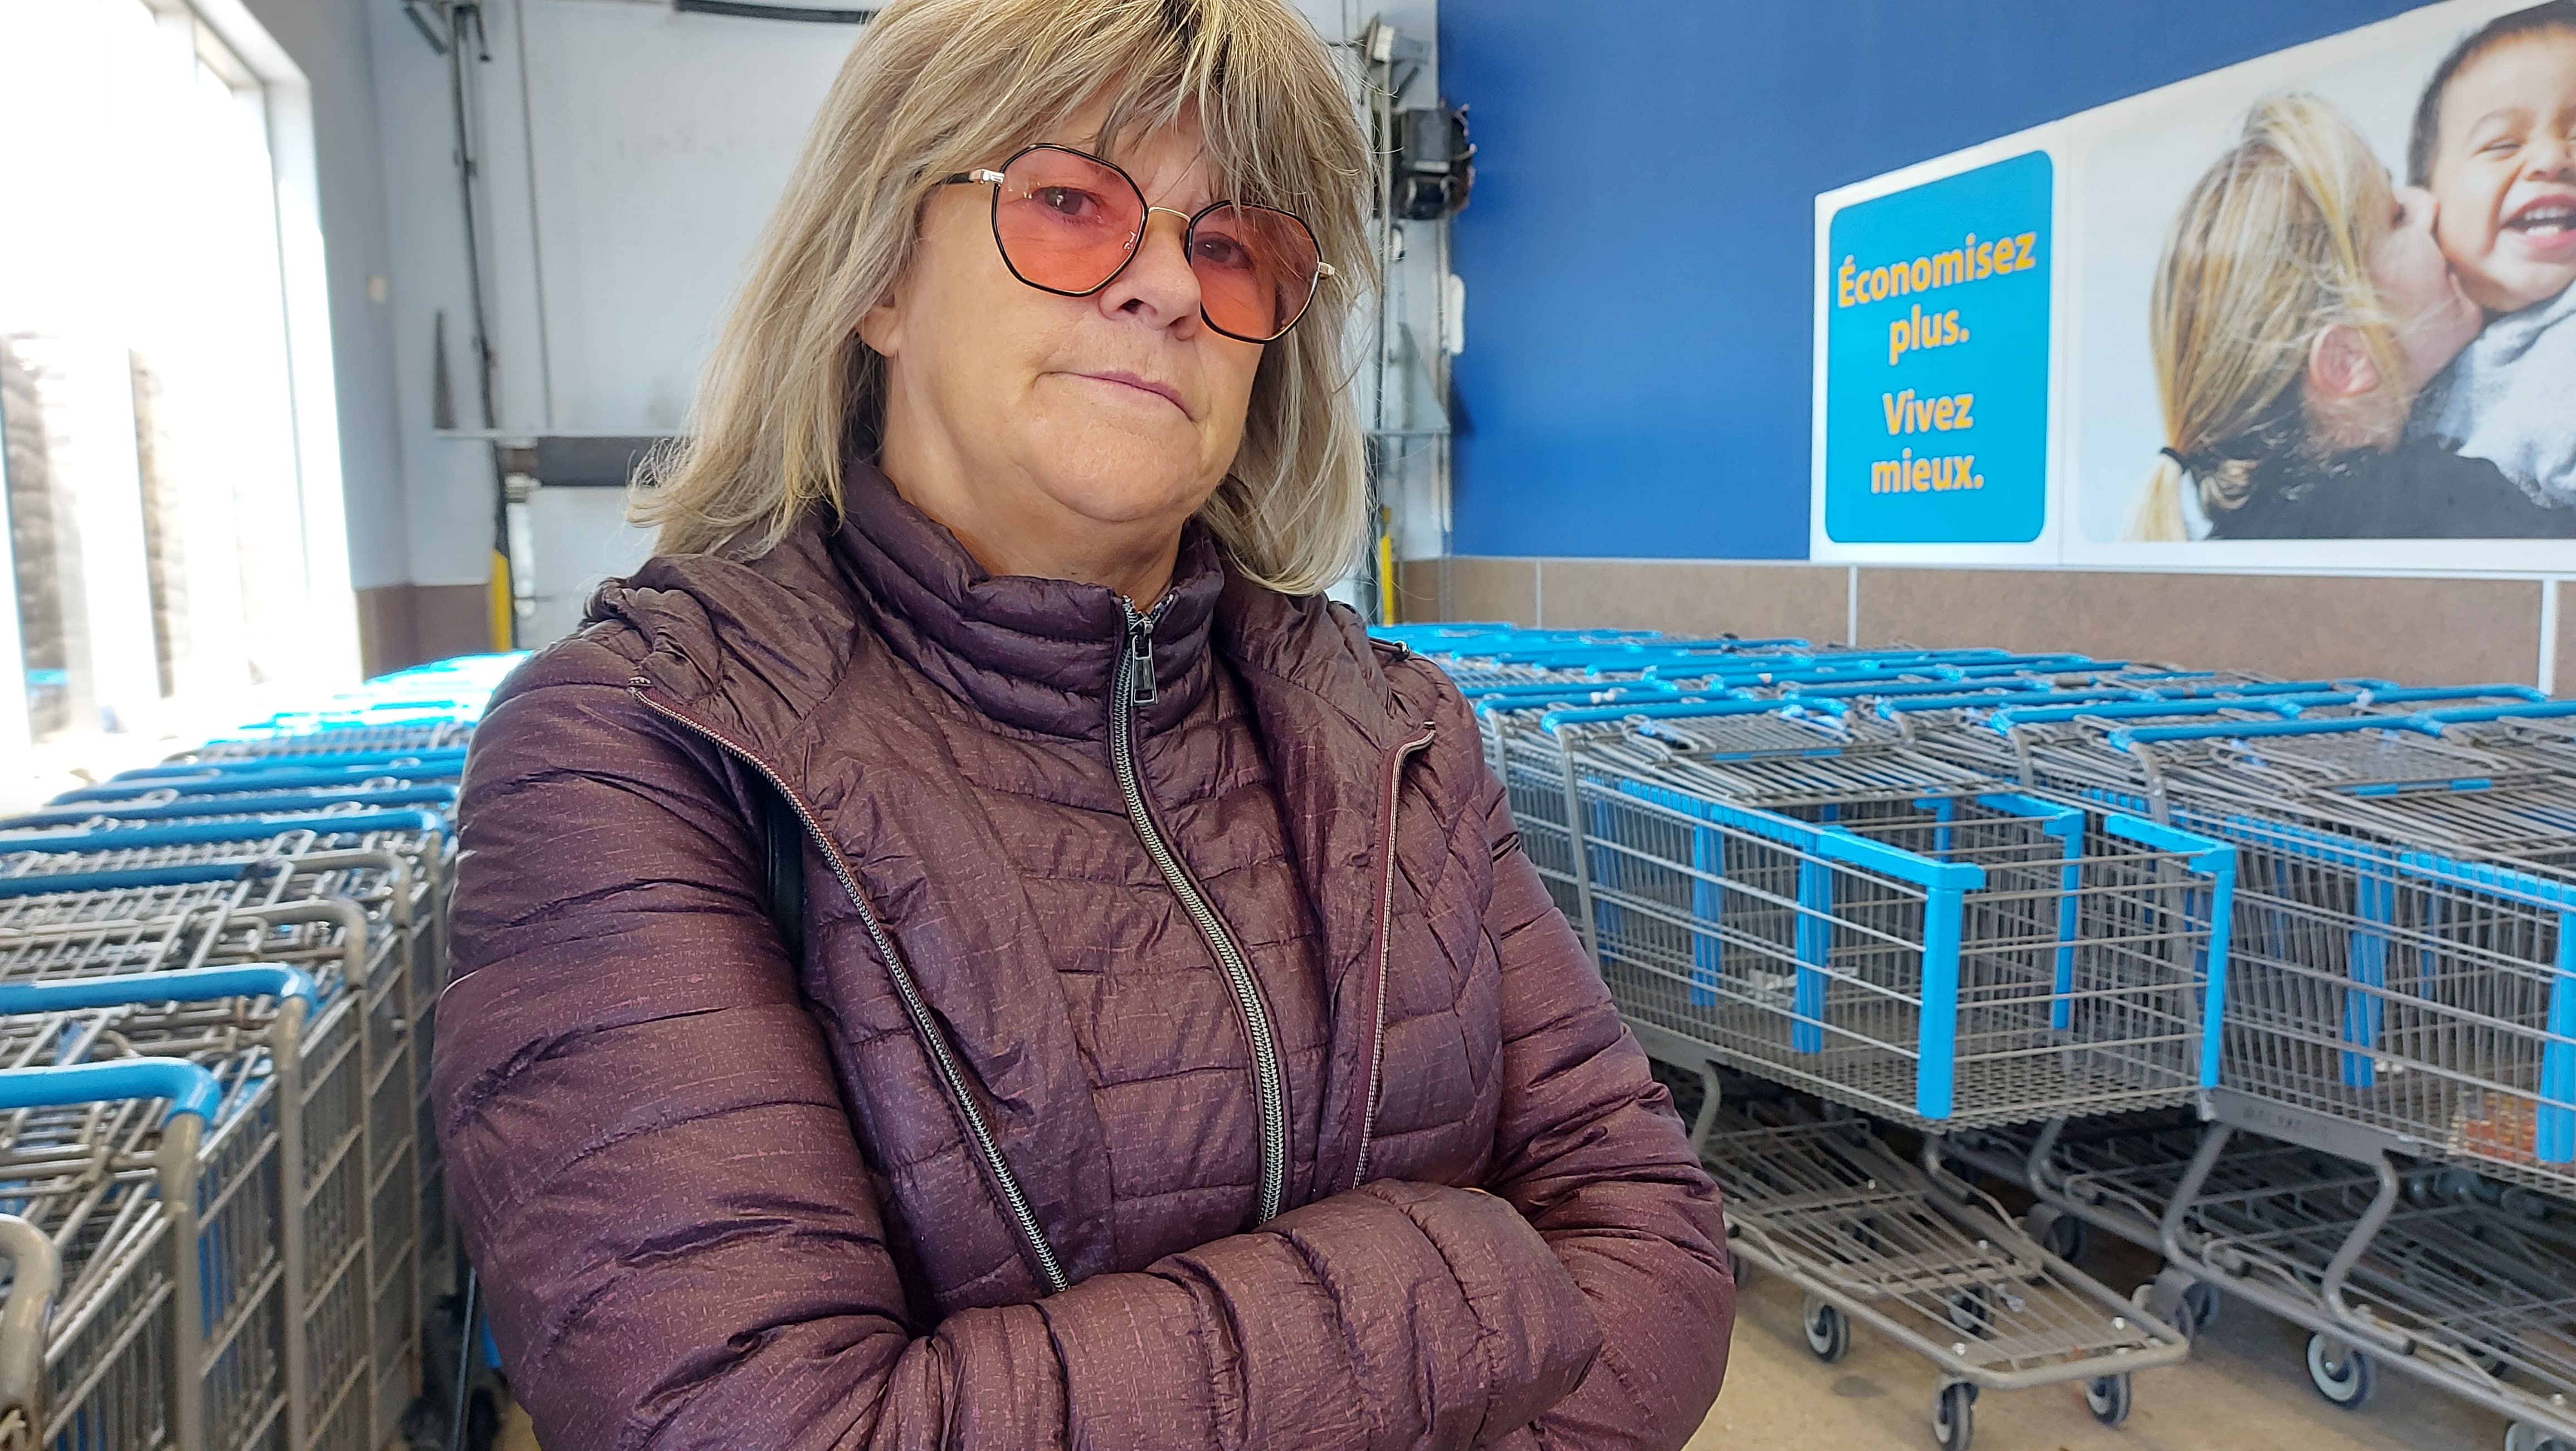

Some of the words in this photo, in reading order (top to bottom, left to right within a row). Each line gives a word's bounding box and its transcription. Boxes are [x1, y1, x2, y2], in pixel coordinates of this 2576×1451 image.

[1837, 232, 2036, 308] Économisez
[1889, 304, 1970, 366] plus.
[1882, 389, 1974, 435] Vivez
[1871, 447, 1984, 493] mieux.
